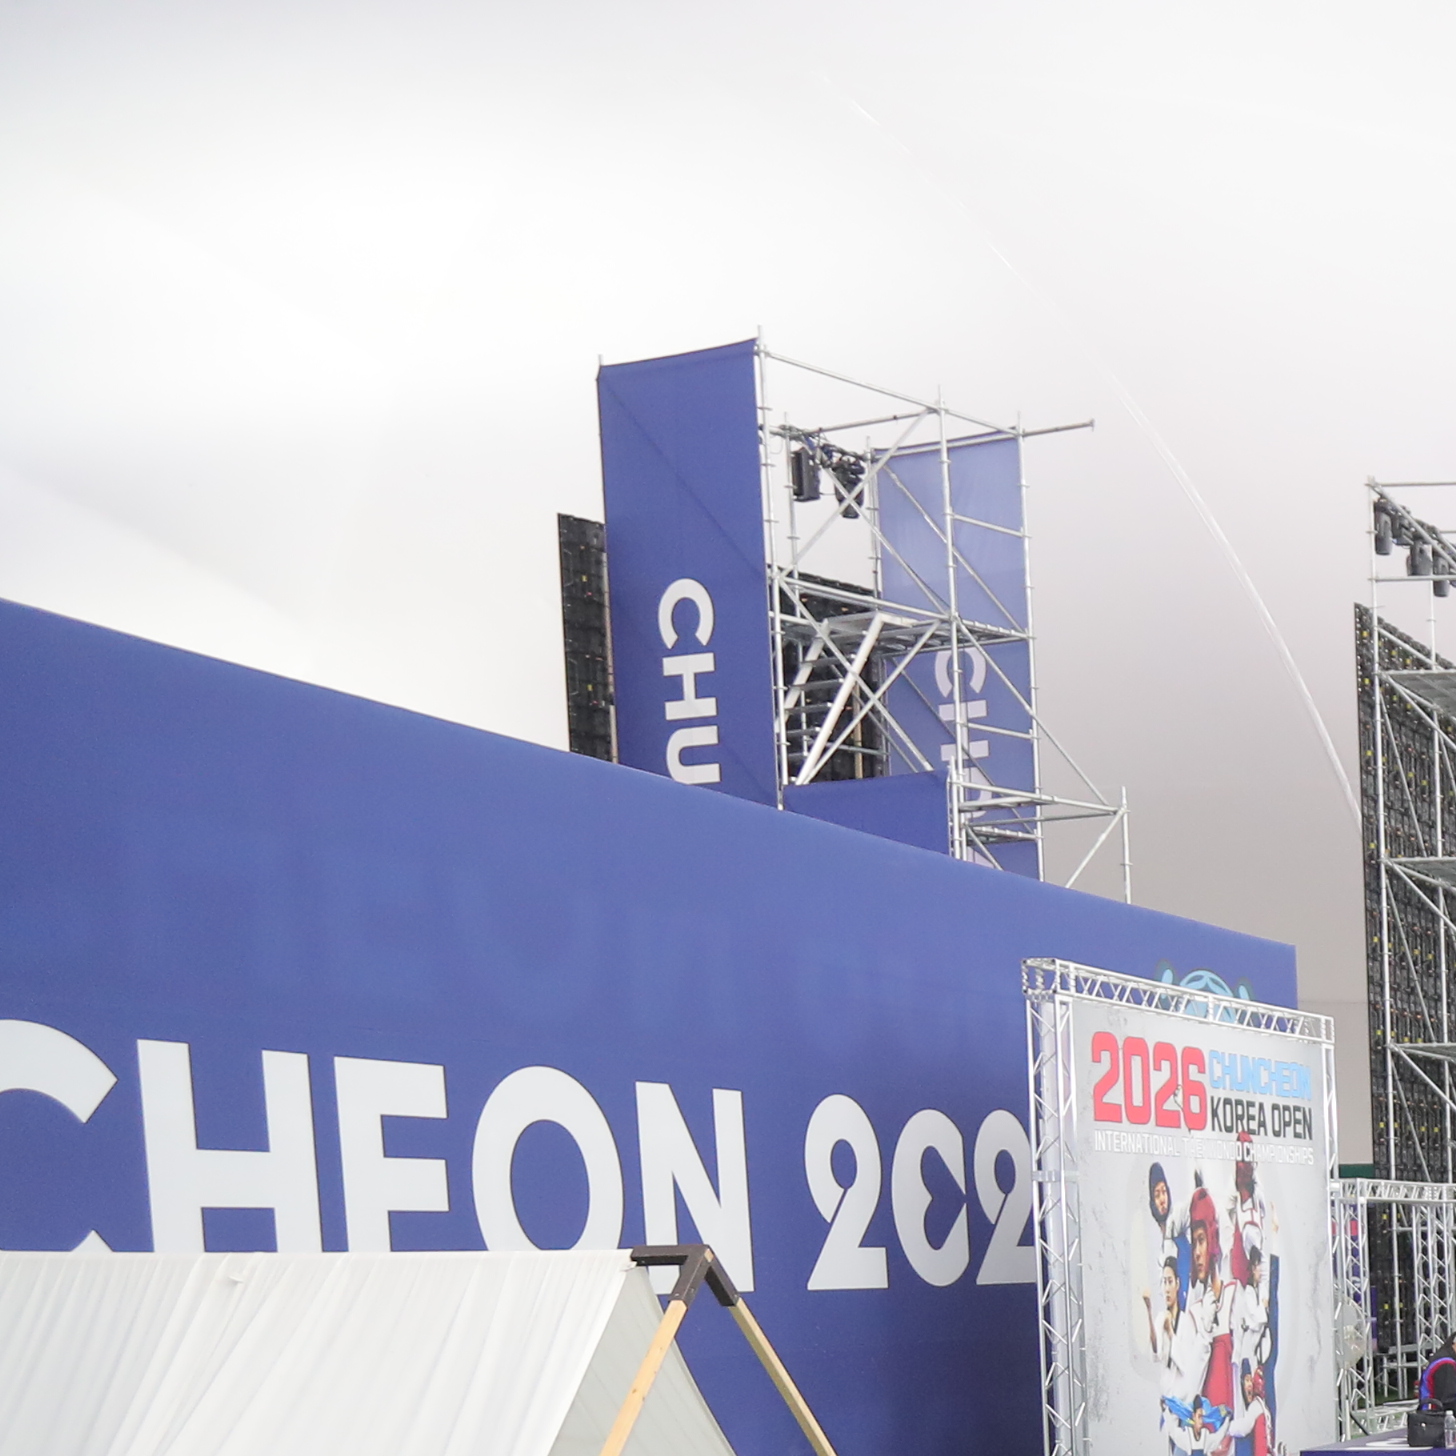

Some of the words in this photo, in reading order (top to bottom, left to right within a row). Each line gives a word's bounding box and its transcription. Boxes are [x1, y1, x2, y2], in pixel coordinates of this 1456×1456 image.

[1091, 1031, 1208, 1131] 2026
[1208, 1050, 1313, 1101] CHUNCHEON
[1210, 1095, 1268, 1137] KOREA
[1271, 1103, 1313, 1141] OPEN
[1094, 1129, 1181, 1158] INTERNATIONAL
[1242, 1140, 1315, 1166] CHAMPIONSHIPS
